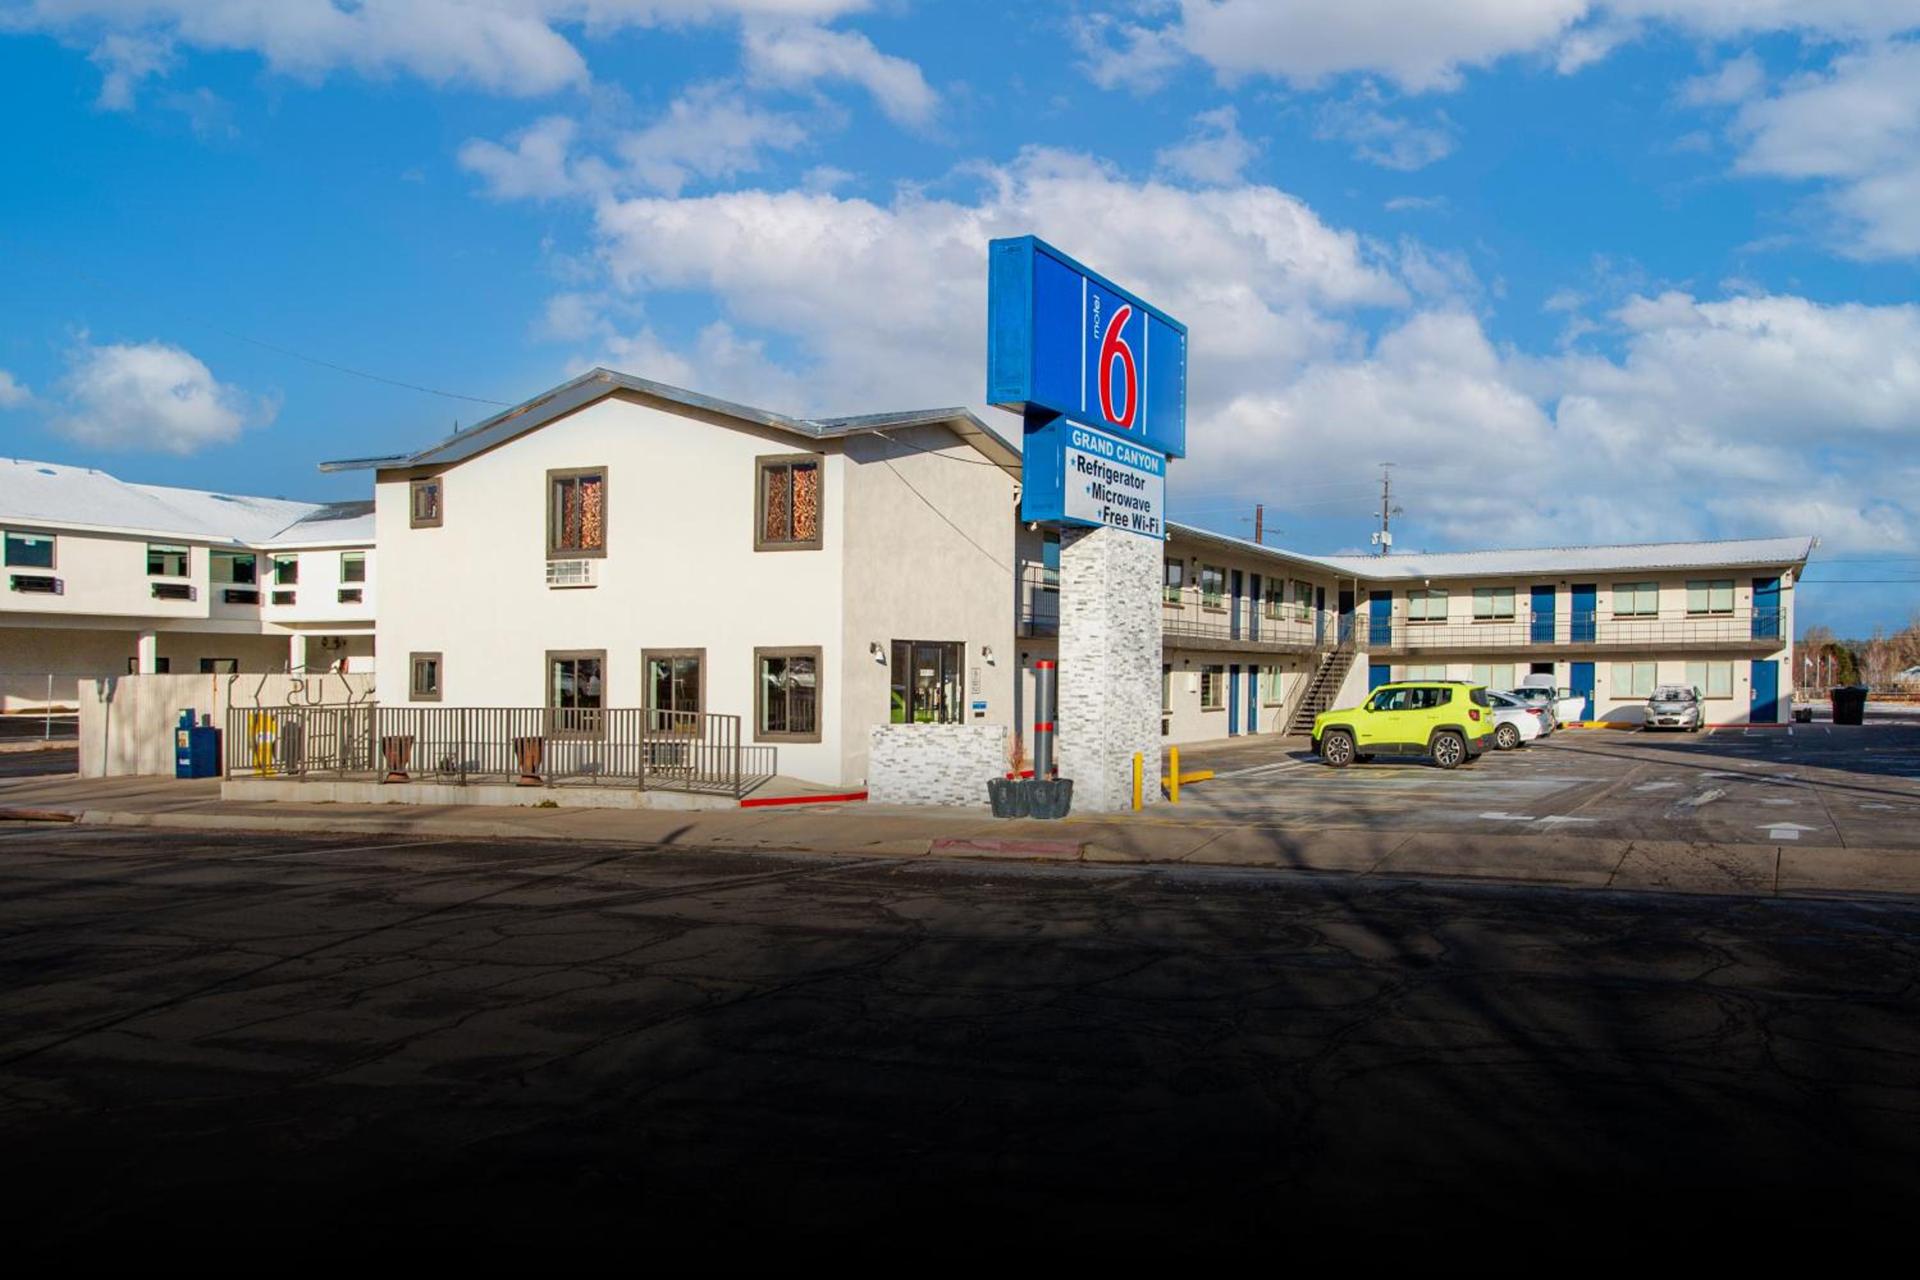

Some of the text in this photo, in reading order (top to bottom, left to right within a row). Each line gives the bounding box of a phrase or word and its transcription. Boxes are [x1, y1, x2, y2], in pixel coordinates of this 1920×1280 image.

[1098, 304, 1138, 430] 6
[1072, 430, 1159, 472] GRAND CANYON
[1077, 455, 1146, 491] Refrigerator
[1092, 482, 1151, 513] Microwave
[1103, 506, 1159, 534] Free Wi-Fi
